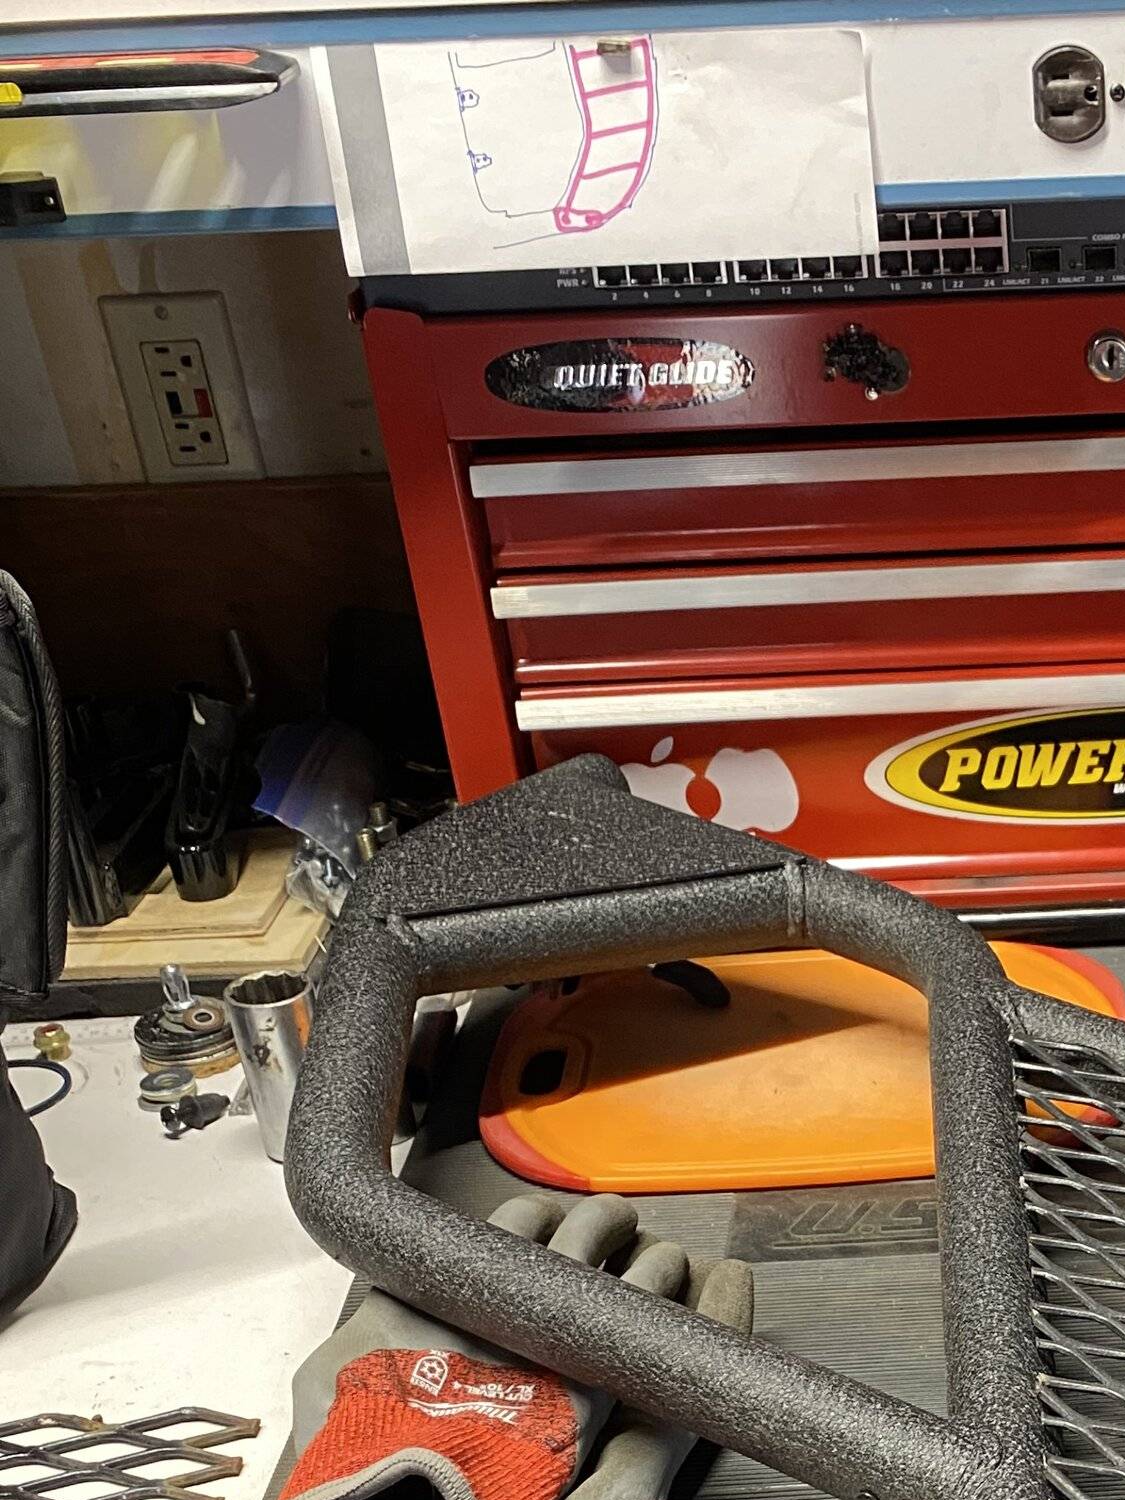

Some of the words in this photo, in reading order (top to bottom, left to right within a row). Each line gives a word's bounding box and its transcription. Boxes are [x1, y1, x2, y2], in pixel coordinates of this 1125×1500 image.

[781, 286, 792, 294] 12
[812, 285, 823, 293] 14
[554, 363, 642, 390] QUIET
[649, 360, 735, 387] GLIDE
[505, 1392, 534, 1401] CUT
